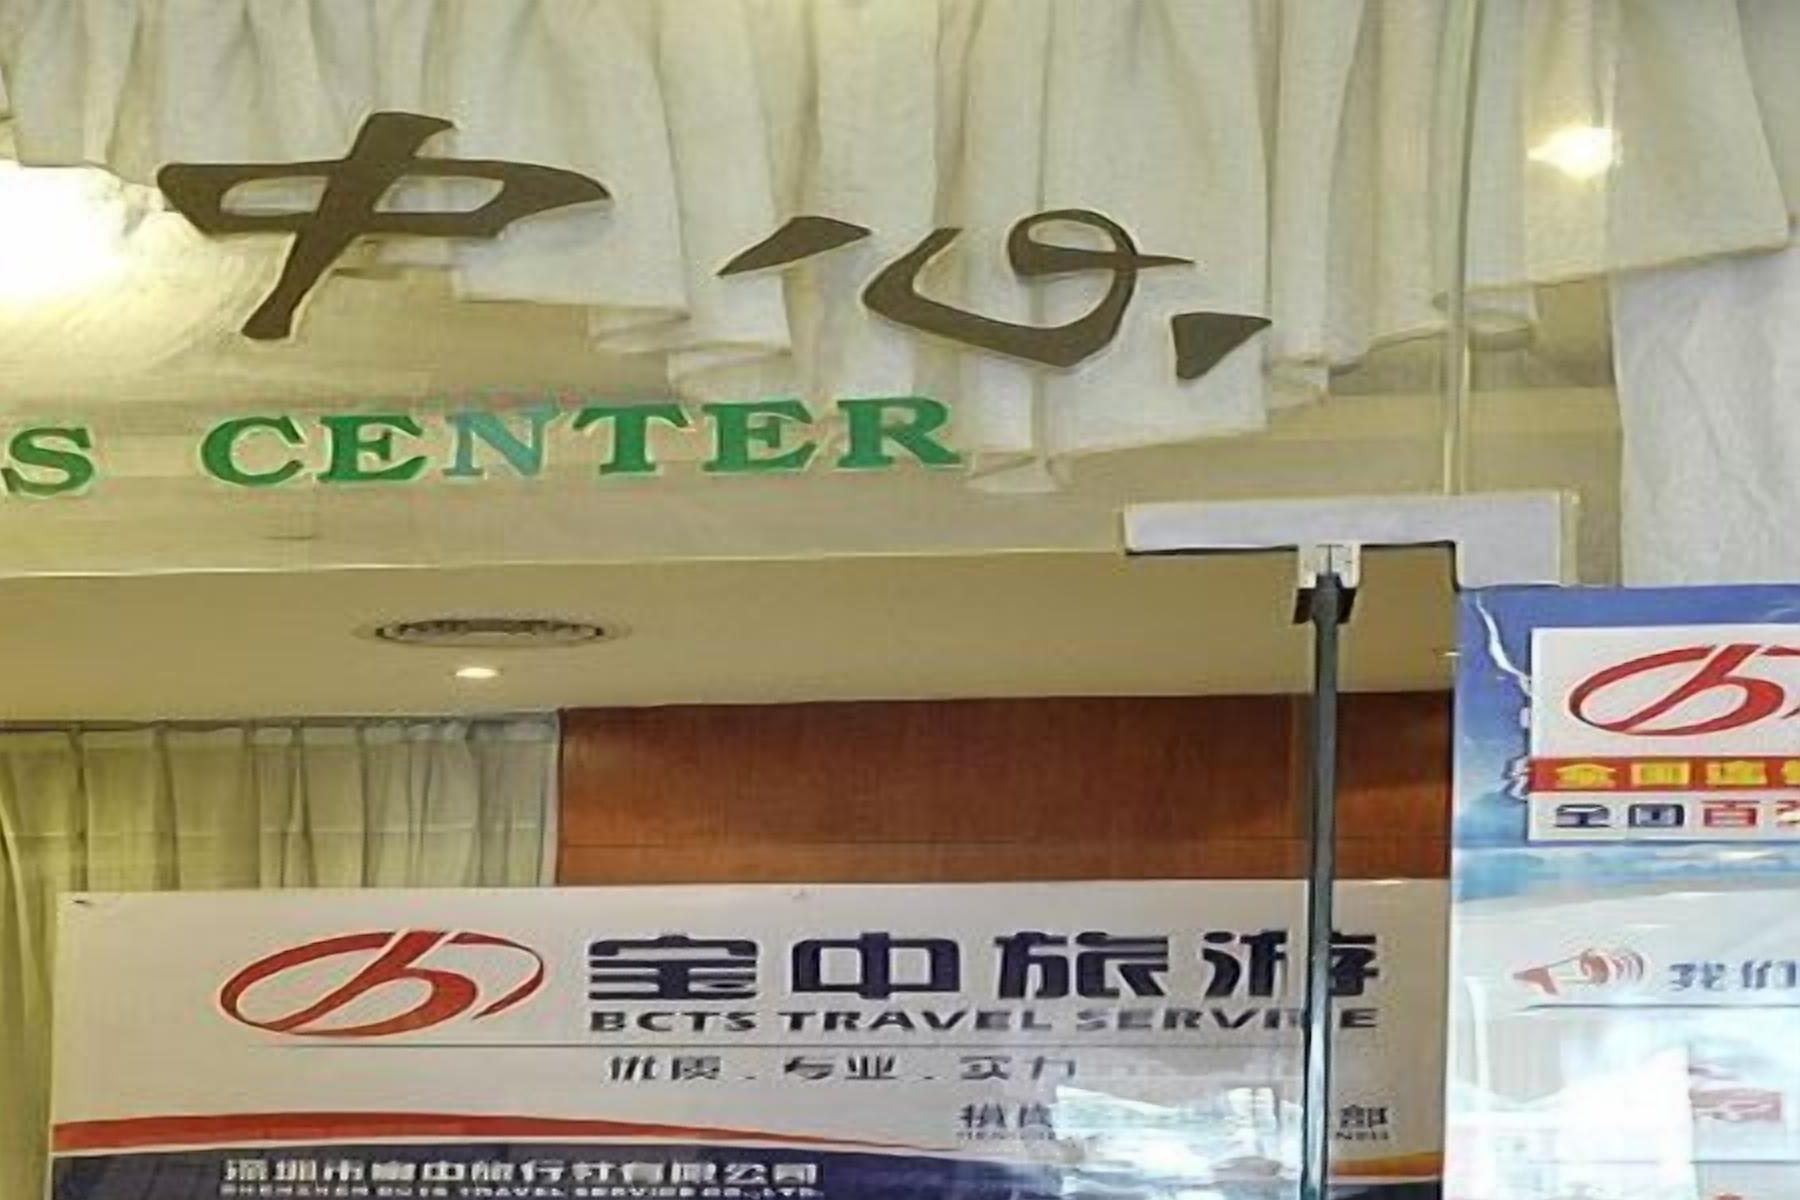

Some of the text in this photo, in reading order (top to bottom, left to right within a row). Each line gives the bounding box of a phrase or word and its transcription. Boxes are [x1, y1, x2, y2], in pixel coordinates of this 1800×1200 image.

[202, 395, 961, 486] CENTER
[588, 931, 1381, 1000] 宝中旅游
[590, 1010, 757, 1032] BCTS
[779, 1009, 1053, 1031] TRAVEL
